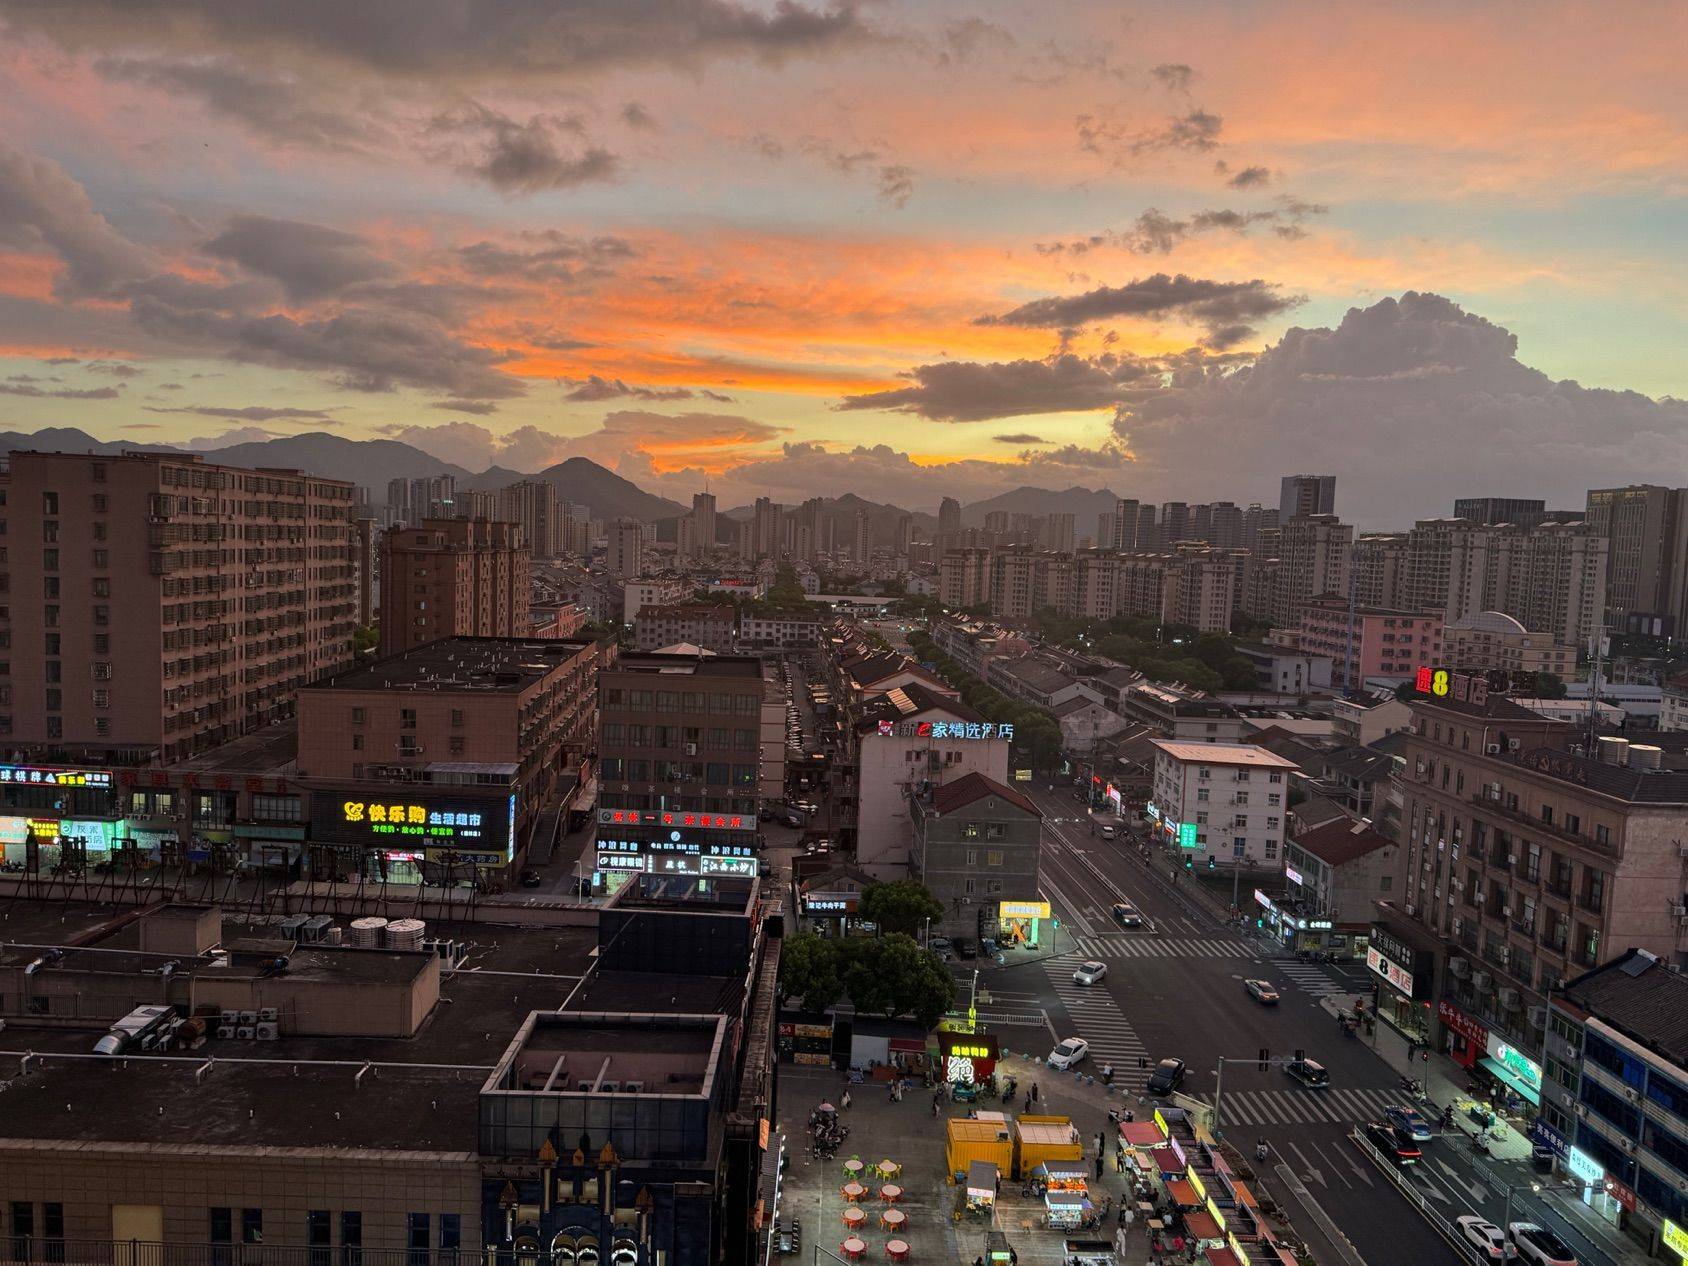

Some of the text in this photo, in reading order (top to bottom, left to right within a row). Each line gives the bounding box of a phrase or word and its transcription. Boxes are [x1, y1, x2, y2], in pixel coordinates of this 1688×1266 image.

[368, 803, 426, 823] 快乐购
[429, 812, 481, 826] 生活超市
